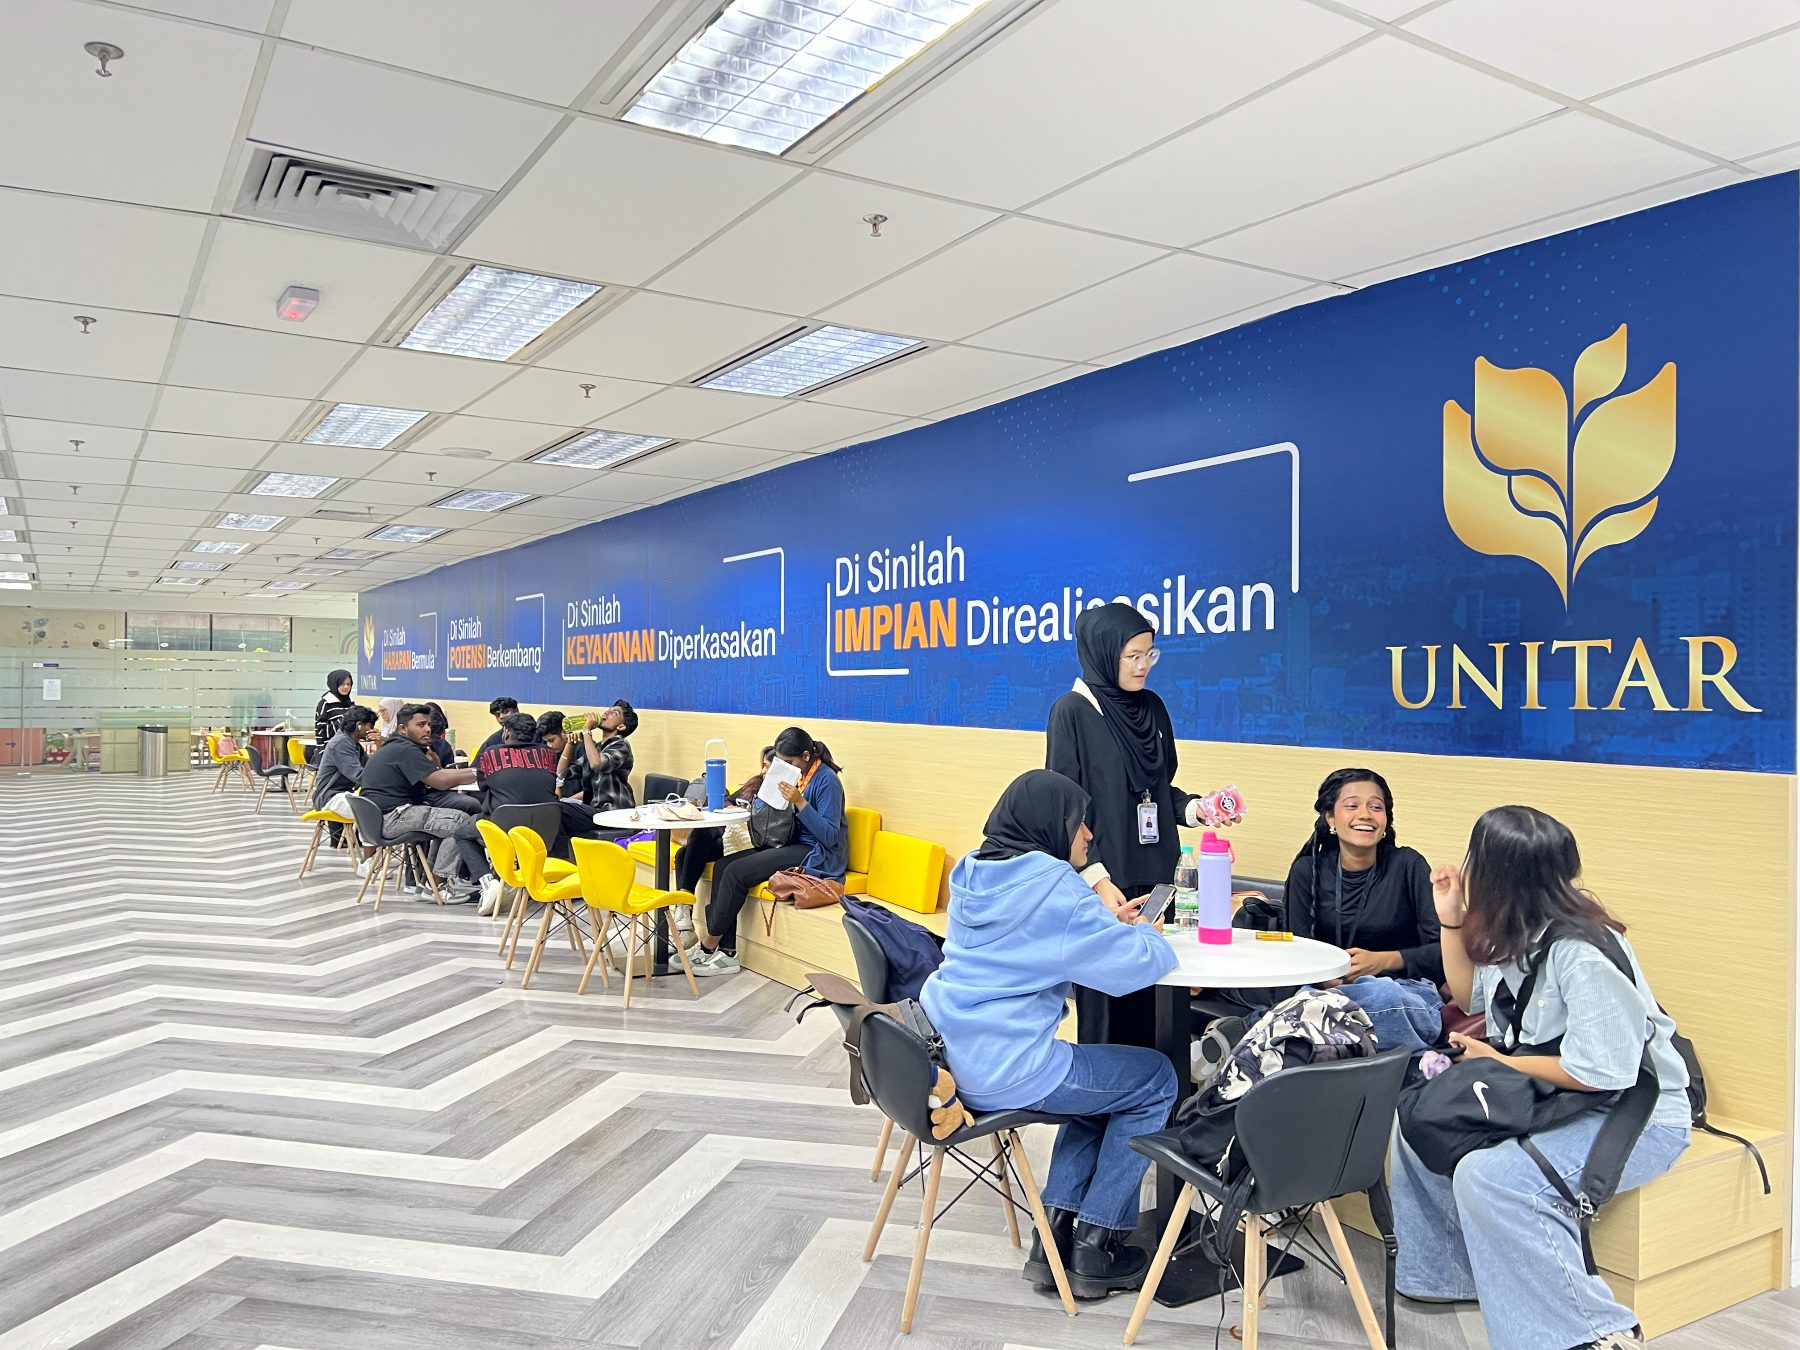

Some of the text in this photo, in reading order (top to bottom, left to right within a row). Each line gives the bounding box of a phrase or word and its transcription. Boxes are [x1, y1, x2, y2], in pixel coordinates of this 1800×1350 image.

[835, 535, 965, 597] Di Sinilah
[451, 615, 482, 641] Di Sinilah
[567, 593, 621, 629] Di Sinilah
[835, 574, 1275, 653] IMPIAN Direalisikan
[383, 626, 406, 647] Di Sinilah
[566, 620, 776, 669] KEYAKINAN Diperkasakan
[411, 648, 435, 670] Bermula
[449, 642, 542, 674] POTENSI Berkembang
[1386, 635, 1763, 713] UNITAR
